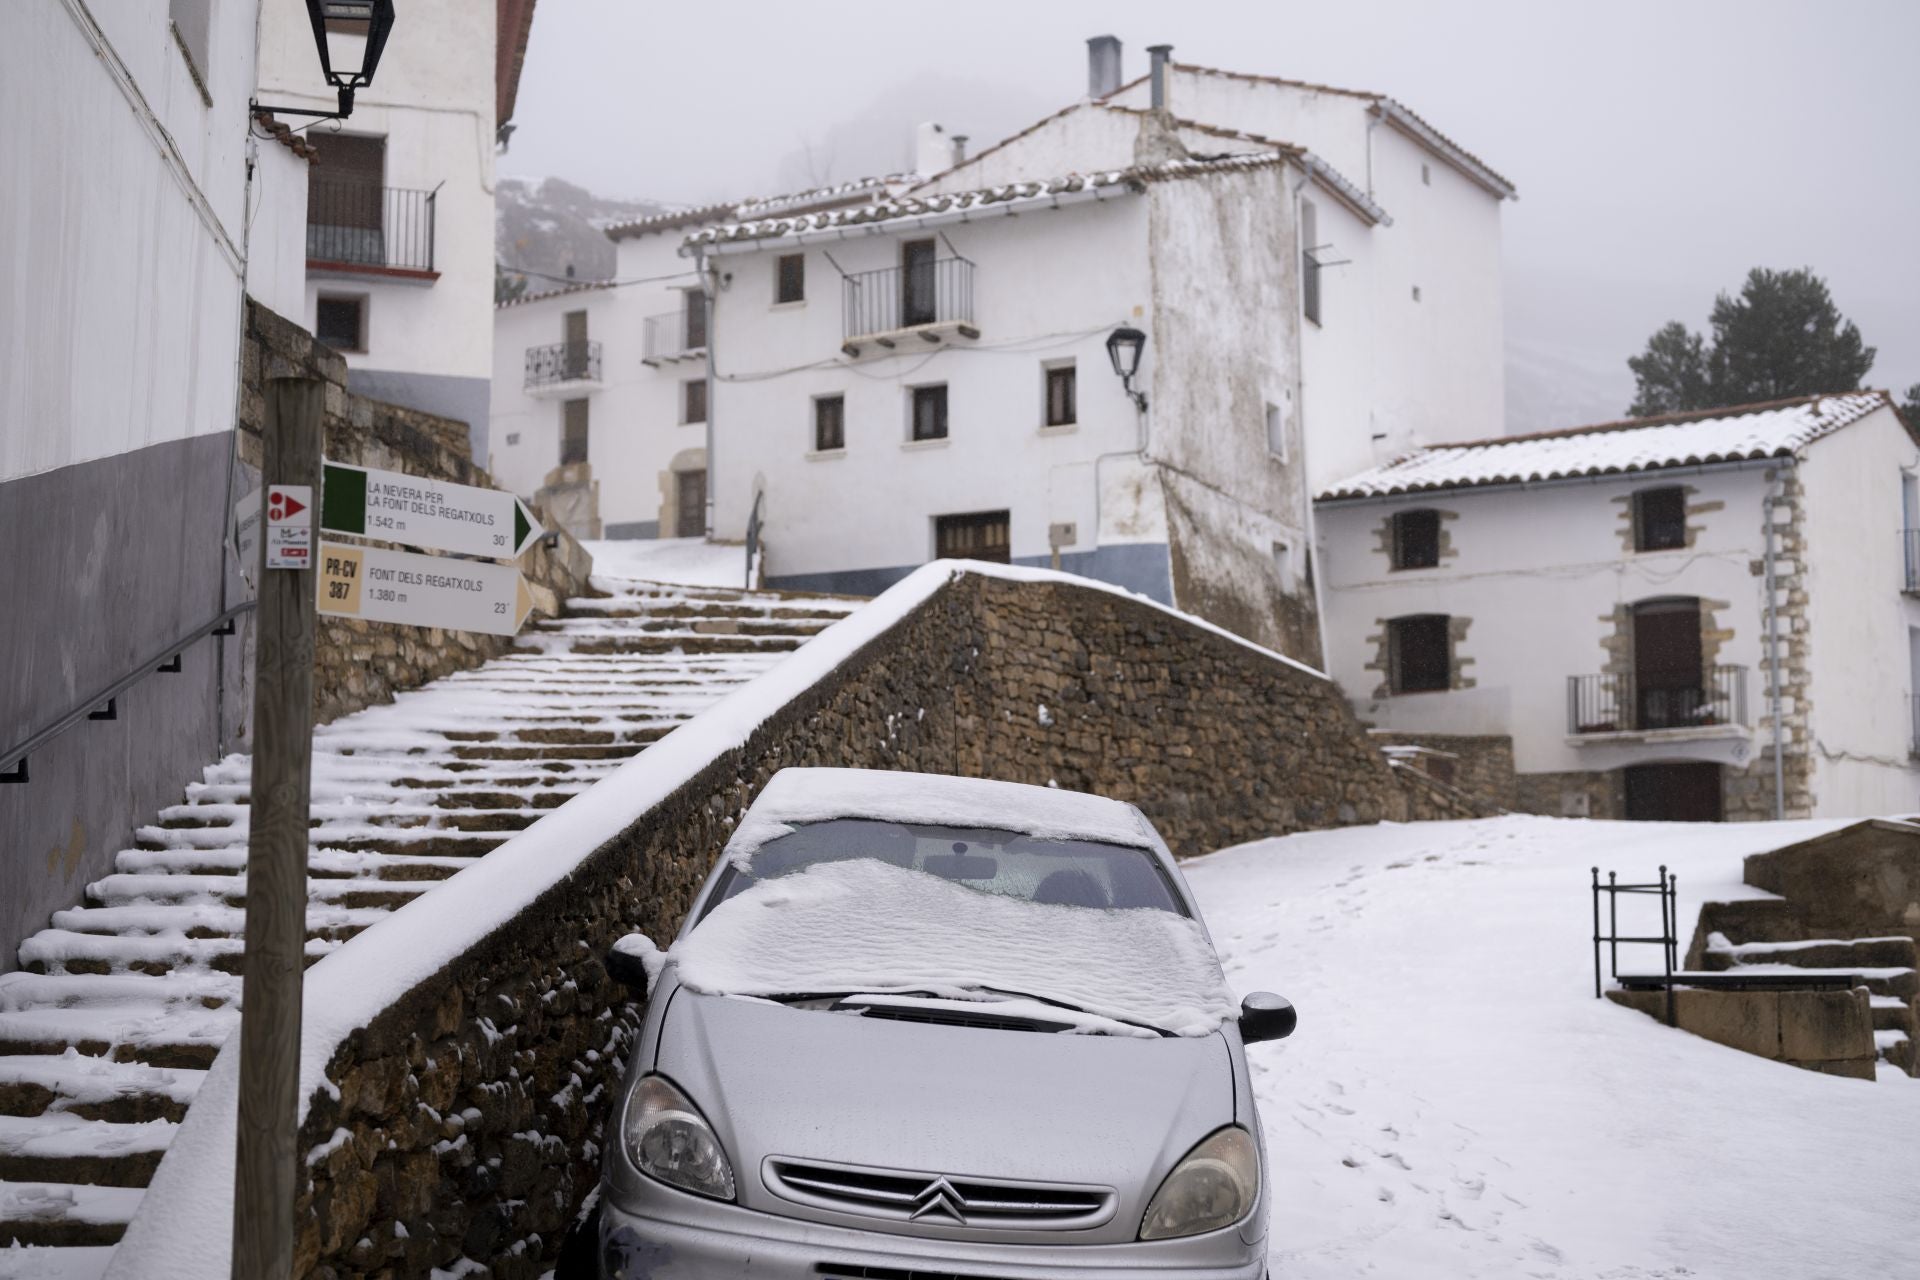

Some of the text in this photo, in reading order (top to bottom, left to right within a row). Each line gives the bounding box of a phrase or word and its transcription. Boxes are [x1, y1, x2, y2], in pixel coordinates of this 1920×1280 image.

[367, 482, 444, 505] LA NEVERA PER
[367, 496, 495, 526] LA FONT DELS REGATXOLS
[367, 515, 406, 530] 1.542 m
[325, 557, 358, 578] PR-CV
[369, 567, 483, 592] FONT DELS REGATXOLS
[328, 581, 351, 600] 387
[368, 588, 407, 603] 1.380 m
